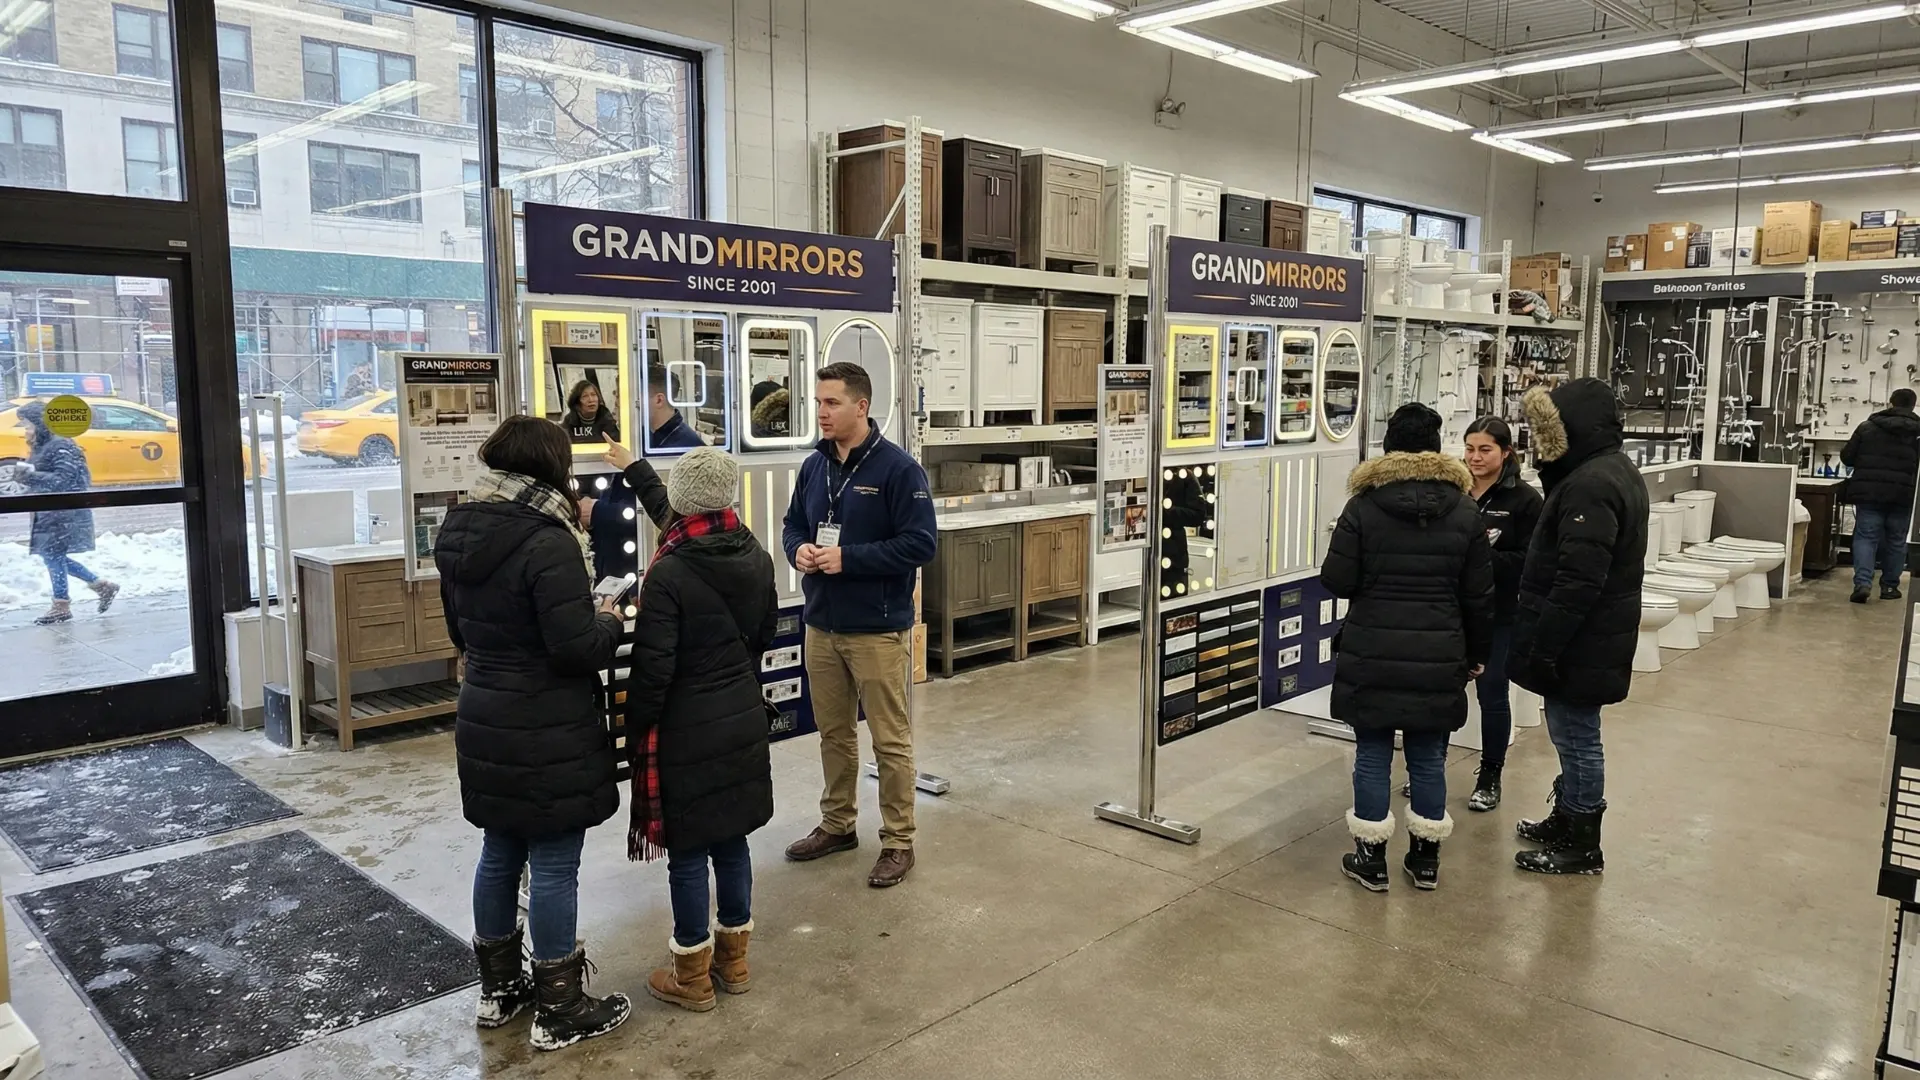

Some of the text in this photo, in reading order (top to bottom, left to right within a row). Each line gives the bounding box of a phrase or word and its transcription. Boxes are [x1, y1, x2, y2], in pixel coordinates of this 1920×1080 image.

[572, 223, 864, 278] GRANDMIRRORS
[1191, 252, 1347, 293] GRANDMIRRORS
[687, 275, 776, 295] SINCE 2001
[1250, 293, 1298, 308] SINCE 2001
[411, 360, 492, 370] GRANDMIRRORS
